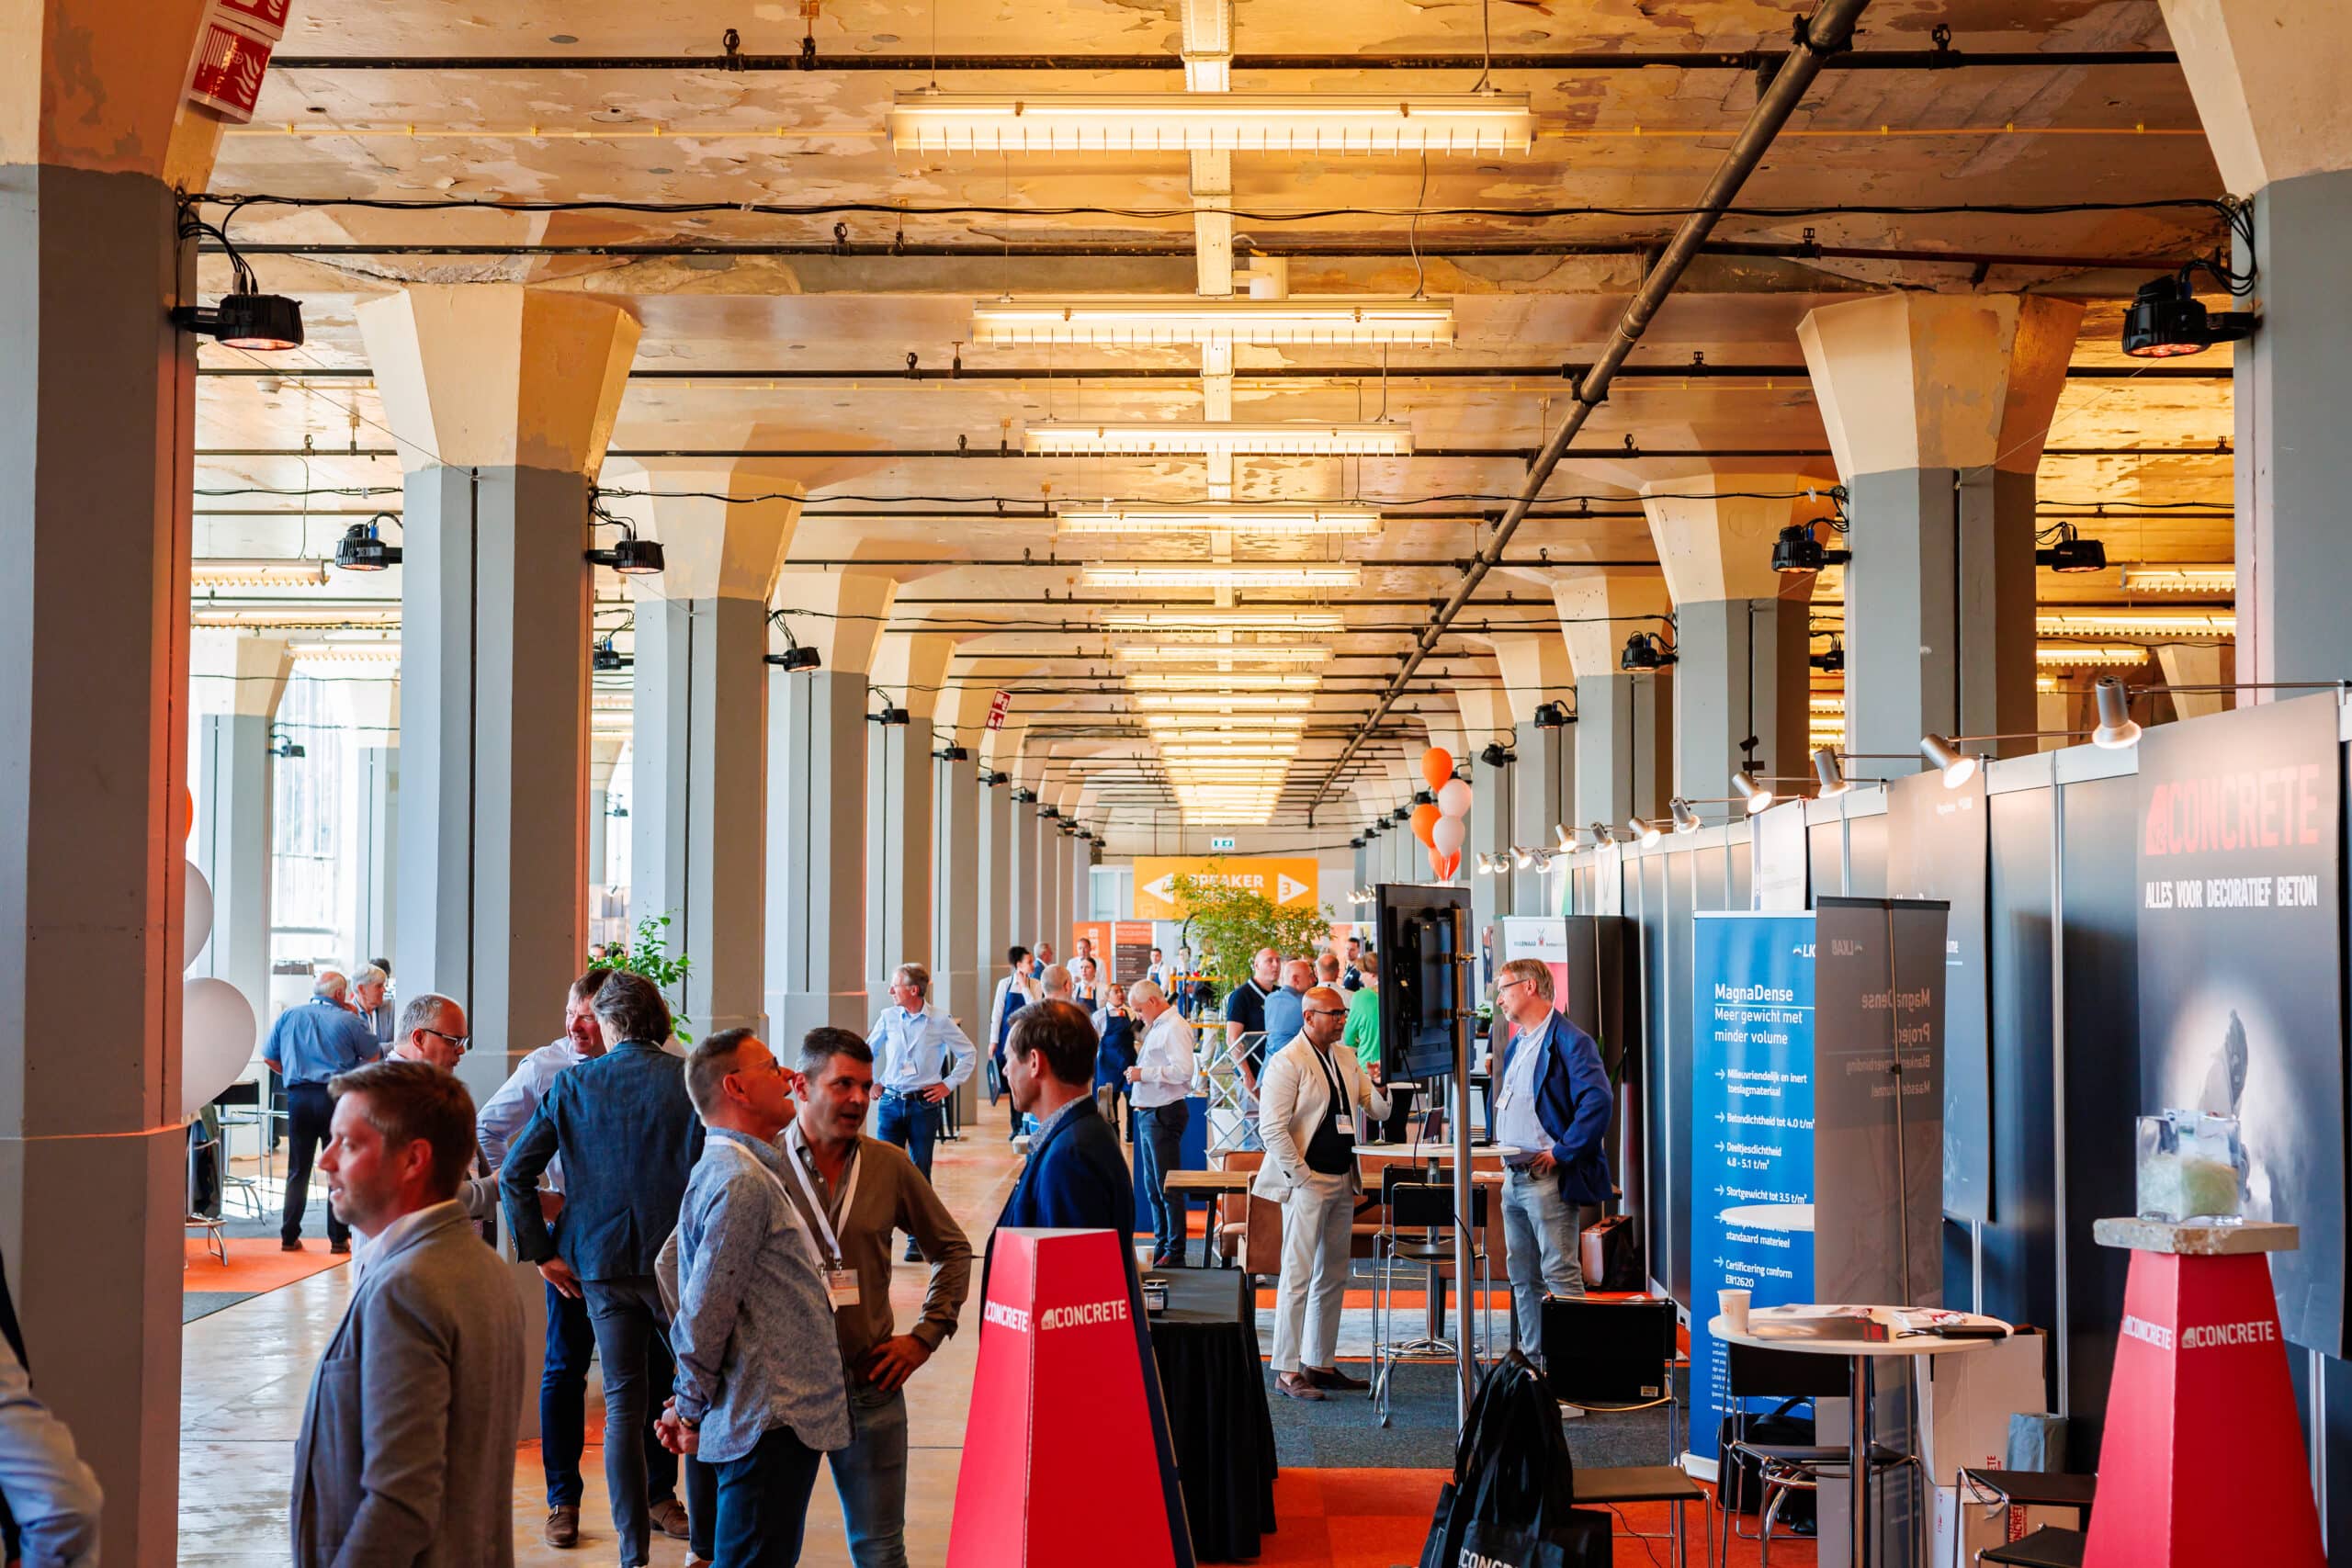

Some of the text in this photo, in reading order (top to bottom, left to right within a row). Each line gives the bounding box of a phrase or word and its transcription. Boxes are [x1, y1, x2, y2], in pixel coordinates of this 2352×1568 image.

[2167, 764, 2319, 854] CONCRETE
[1189, 874, 1264, 888] SPEAKER
[1282, 882, 1291, 896] 3
[2145, 874, 2318, 908] ALLES VOOR DECORATIEF BETON
[1714, 983, 1793, 1003] MagnaDense
[1714, 1007, 1803, 1024] Meer gewicht met
[1714, 1029, 1788, 1045] minder volume
[1781, 1074, 1789, 1082] en
[1790, 1073, 1807, 1084] inert
[1776, 1118, 1786, 1127] tot
[1787, 1119, 1798, 1129] 4.0
[1741, 1159, 1752, 1168] 5.1
[1726, 1186, 1768, 1201] Stortgewicht
[1769, 1191, 1778, 1201] tot
[1780, 1193, 1790, 1203] 3.5
[1725, 1231, 1790, 1248] standaard materieel
[1725, 1259, 1792, 1280] Certificering conform
[985, 1300, 1029, 1333] CONCRETE
[1057, 1300, 1127, 1328] CONCRETE
[2130, 1317, 2172, 1350] CONCRETE
[2197, 1321, 2275, 1348] CONCRETE
